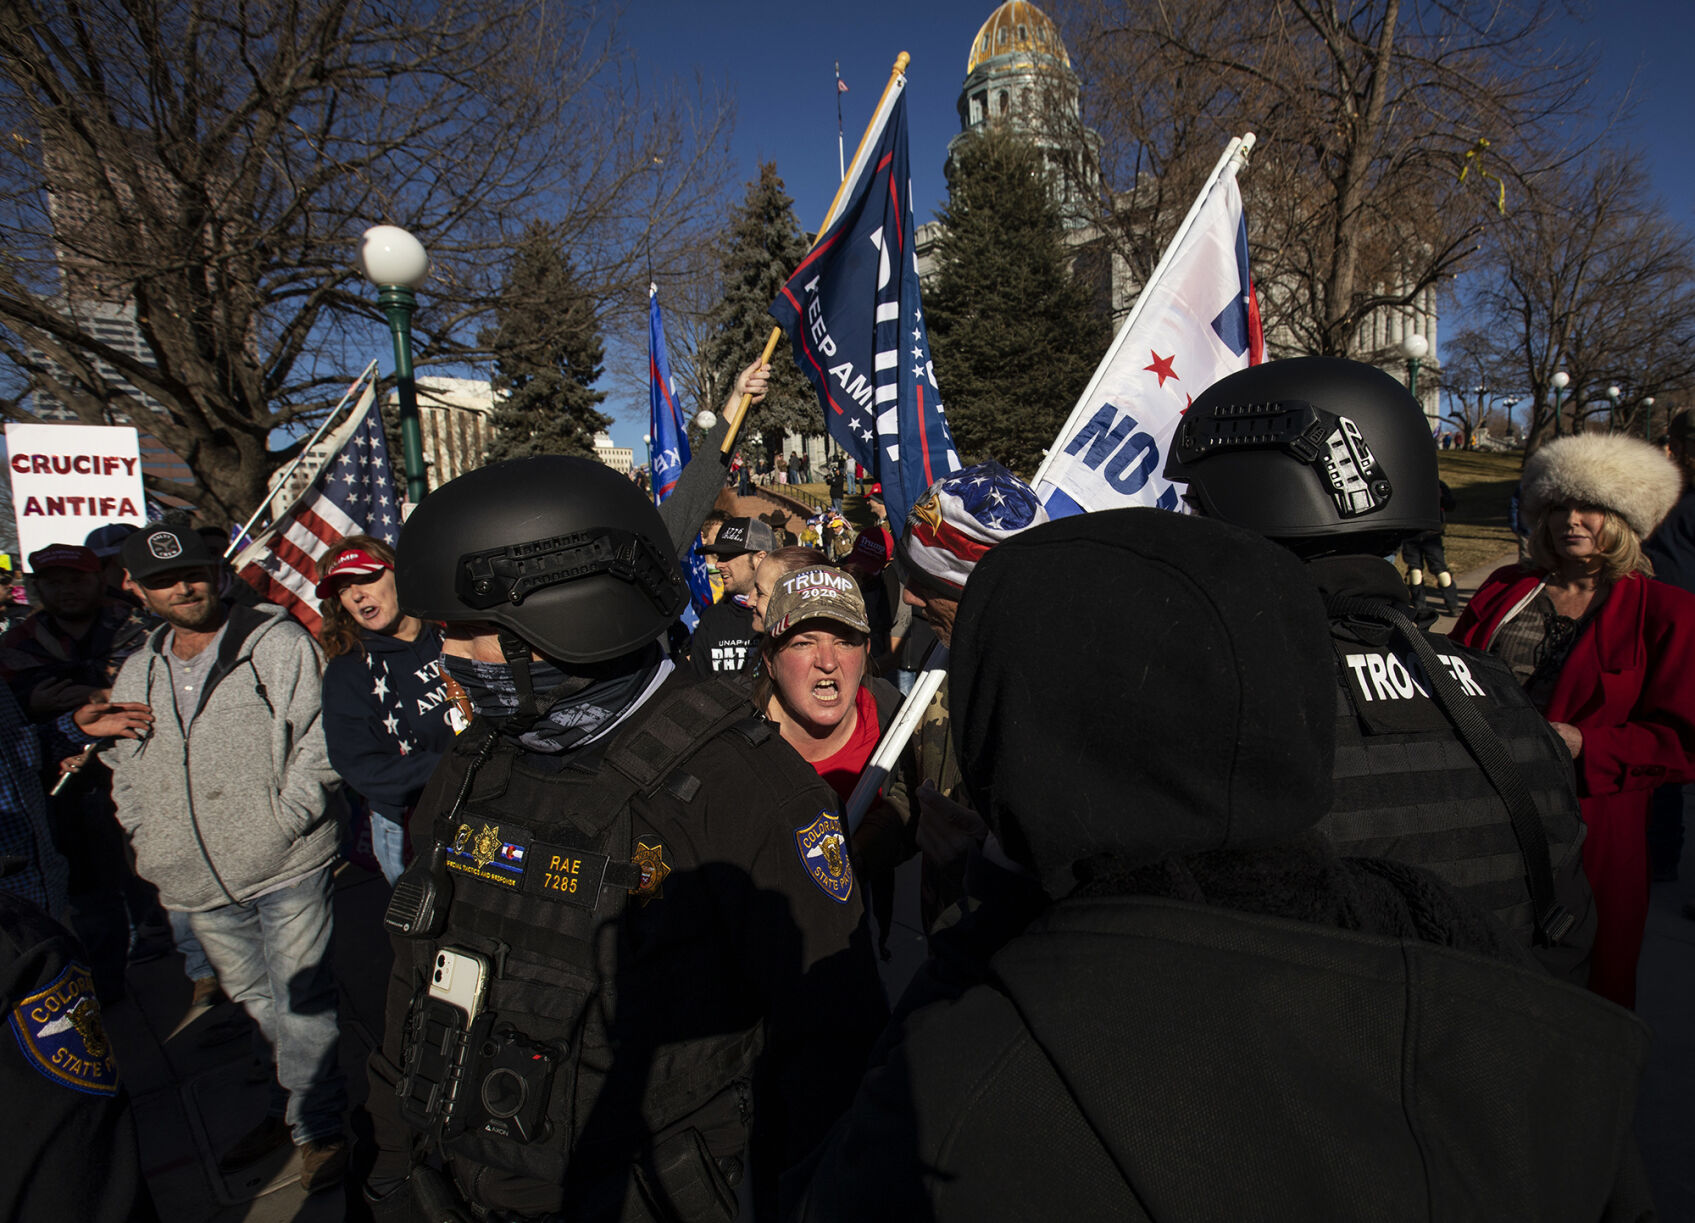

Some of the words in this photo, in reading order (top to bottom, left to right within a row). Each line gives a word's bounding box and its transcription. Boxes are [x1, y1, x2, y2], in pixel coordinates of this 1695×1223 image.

[804, 275, 837, 357] KEEP
[11, 453, 138, 476] CRUCIFY
[23, 495, 139, 517] ANTIFA
[783, 570, 853, 594] TRUMP
[801, 588, 837, 600] 2020
[549, 855, 582, 876] RAE
[544, 872, 578, 894] 7285
[814, 866, 838, 891] STATE
[51, 1047, 103, 1078] STATE
